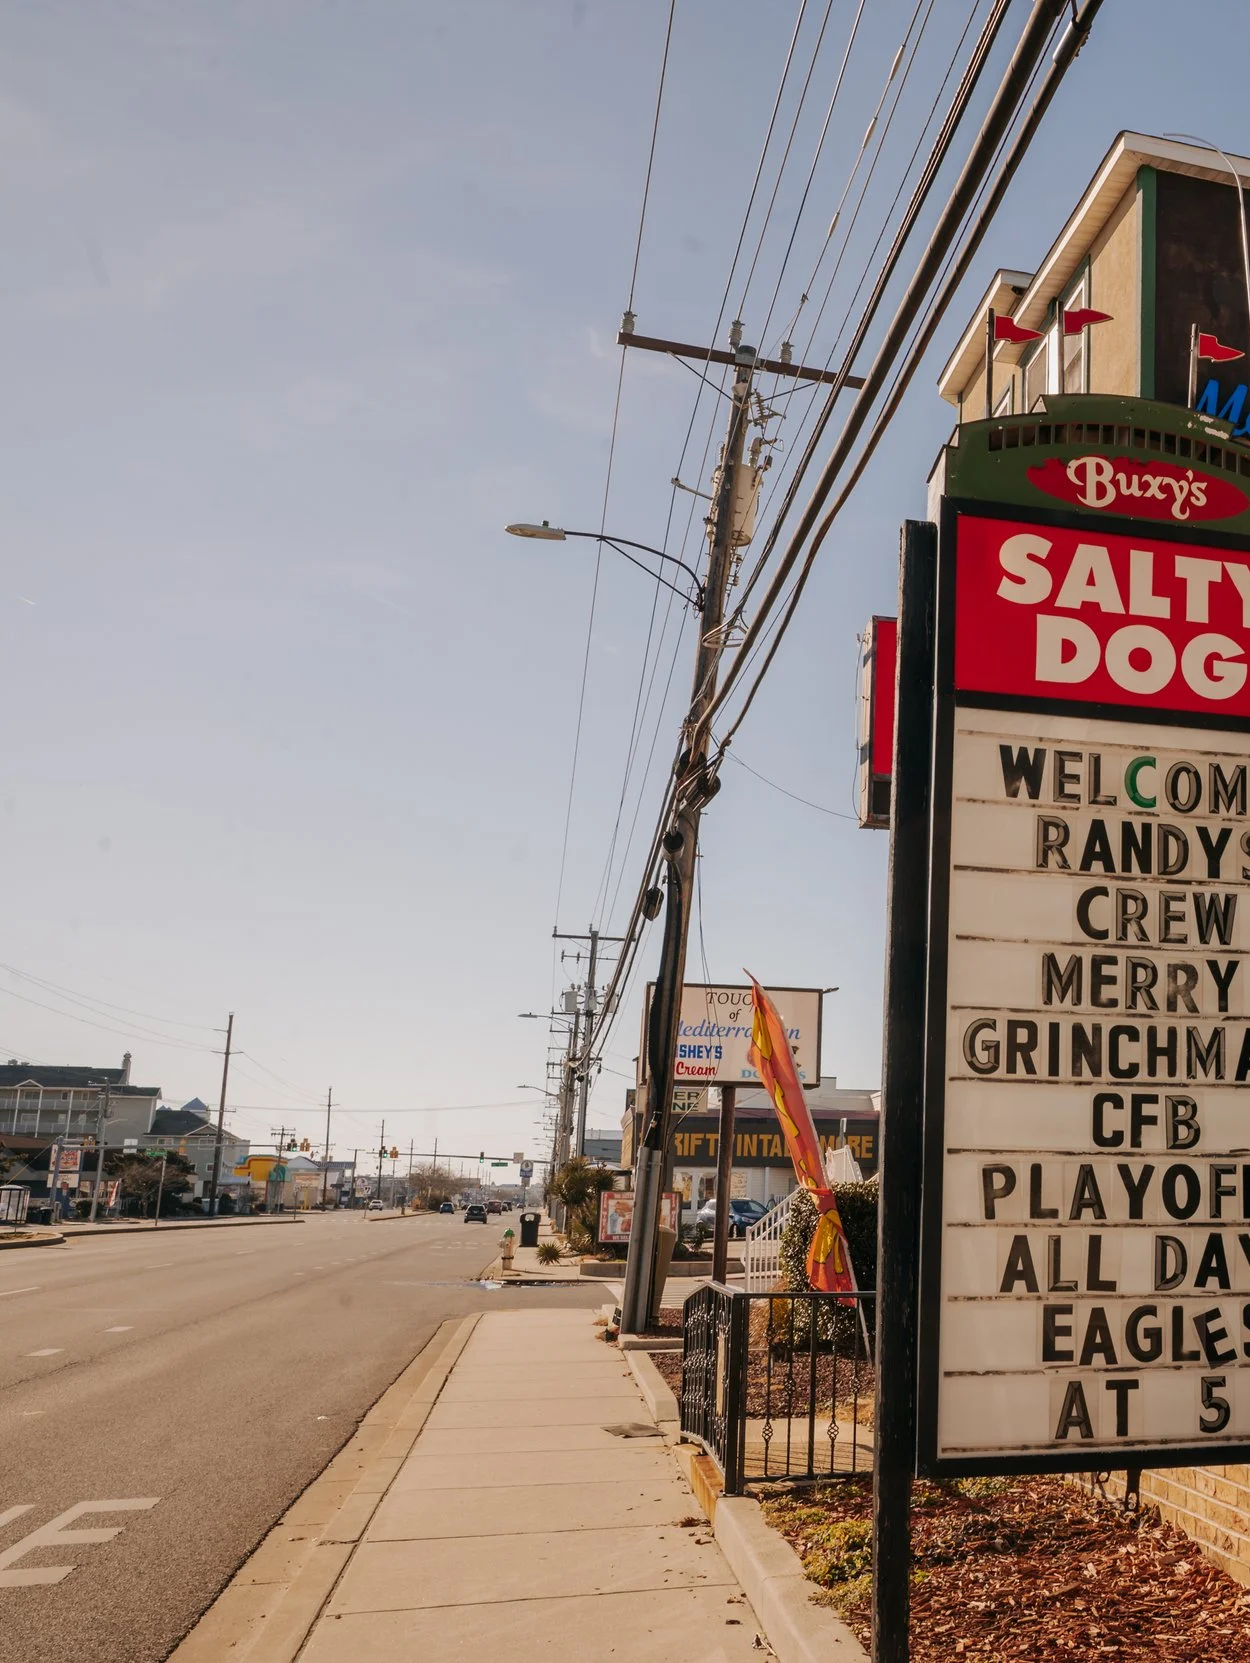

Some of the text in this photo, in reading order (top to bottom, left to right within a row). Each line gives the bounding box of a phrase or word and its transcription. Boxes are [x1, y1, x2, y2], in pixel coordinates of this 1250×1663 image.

[1067, 456, 1207, 520] Buxy's
[1035, 613, 1248, 700] DOG
[1077, 886, 1237, 945] CREW
[1042, 952, 1240, 1013] MERRY
[729, 1009, 742, 1022] of
[676, 1044, 723, 1060] SHEY'S
[676, 1061, 716, 1076] Cream
[1093, 1092, 1200, 1150] CFB
[999, 1234, 1117, 1293] ALL
[1055, 1376, 1231, 1440] AT 5
